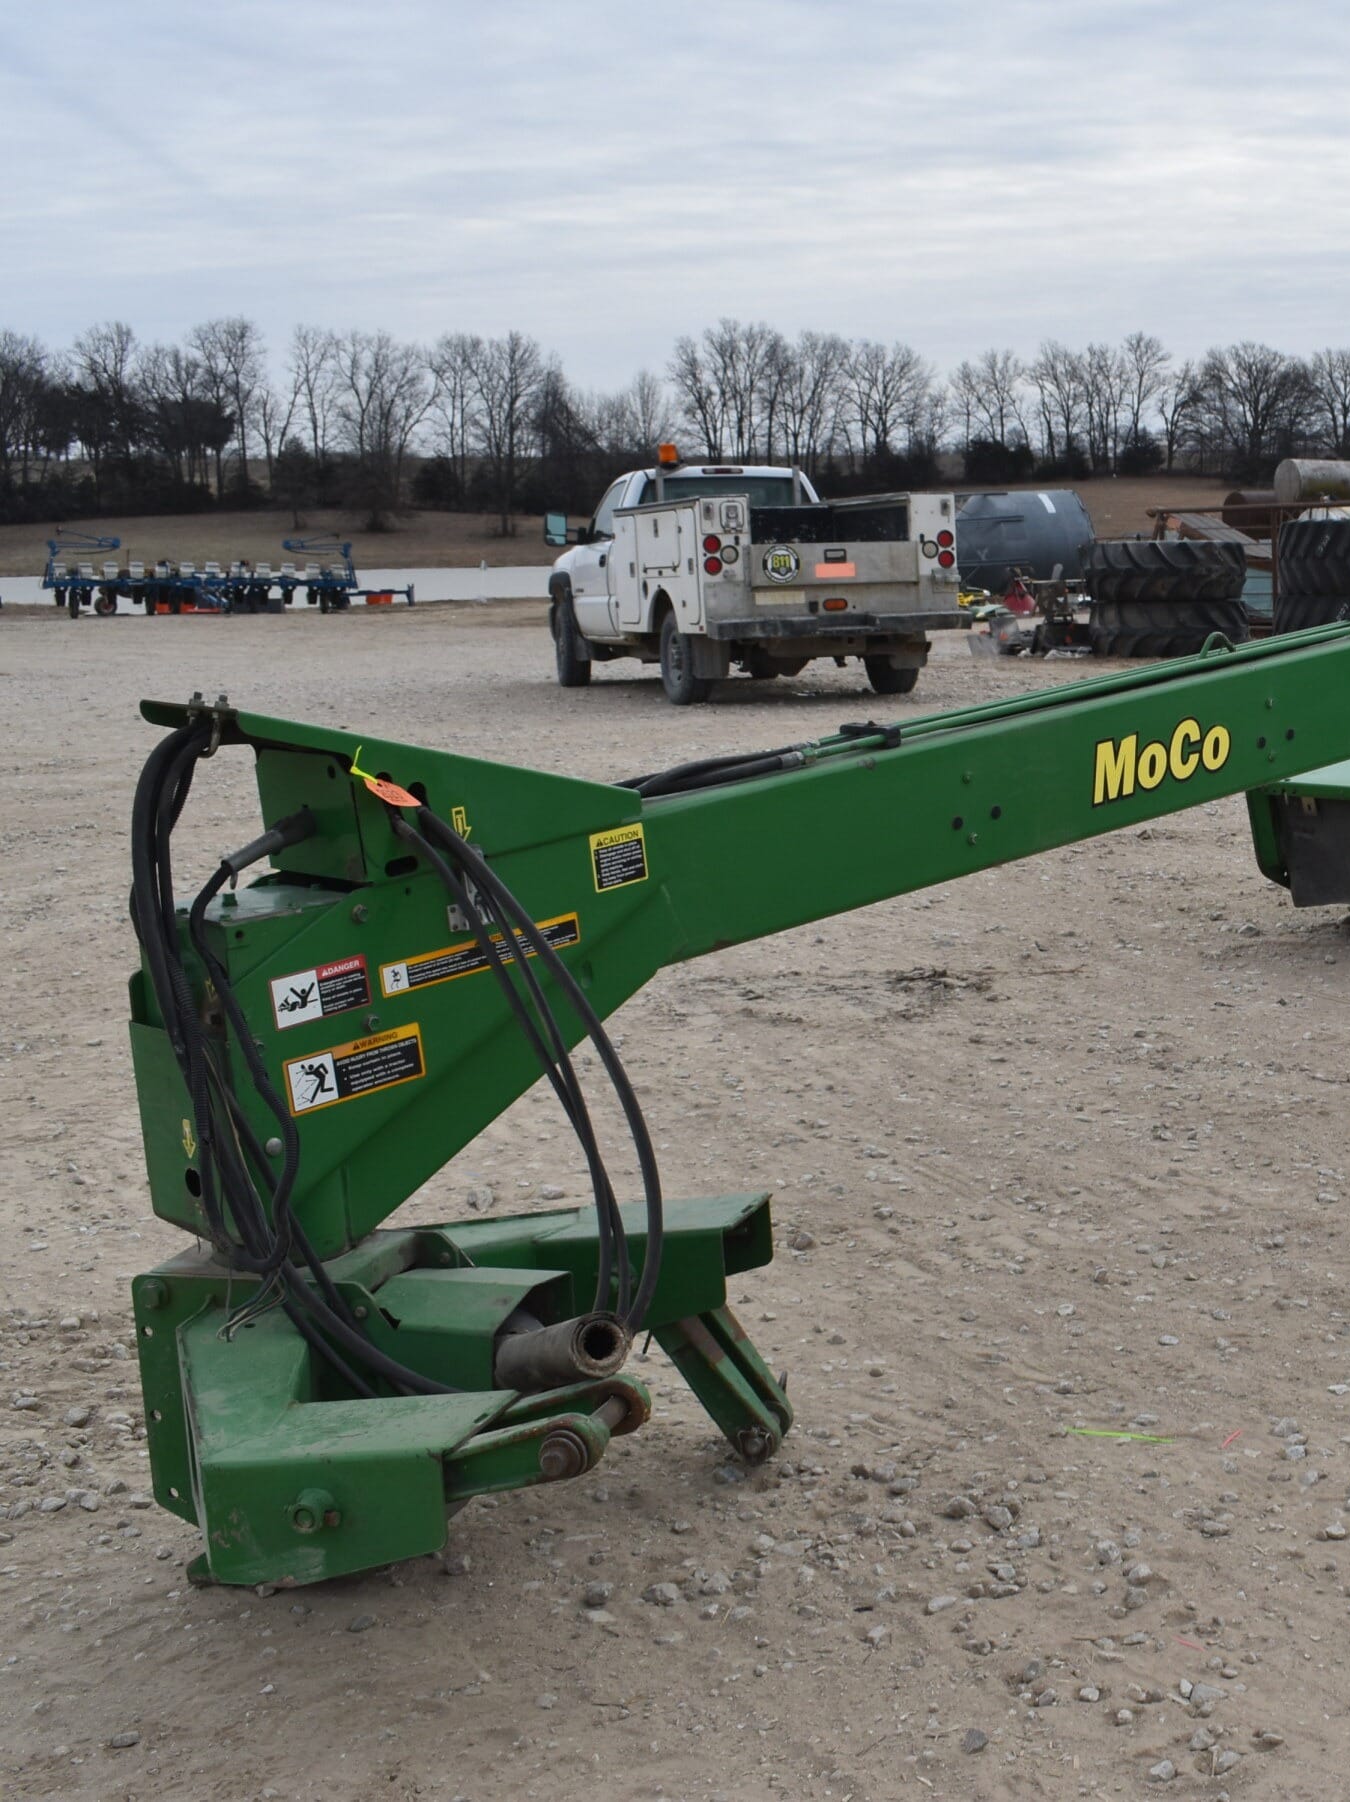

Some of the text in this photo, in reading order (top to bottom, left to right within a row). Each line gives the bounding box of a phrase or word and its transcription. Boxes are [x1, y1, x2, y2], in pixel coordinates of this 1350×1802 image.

[772, 554, 791, 569] 811
[1092, 716, 1231, 808] MoCo
[603, 830, 639, 846] CAUTION
[327, 960, 360, 975] DANGER
[359, 1032, 398, 1048] WARNING
